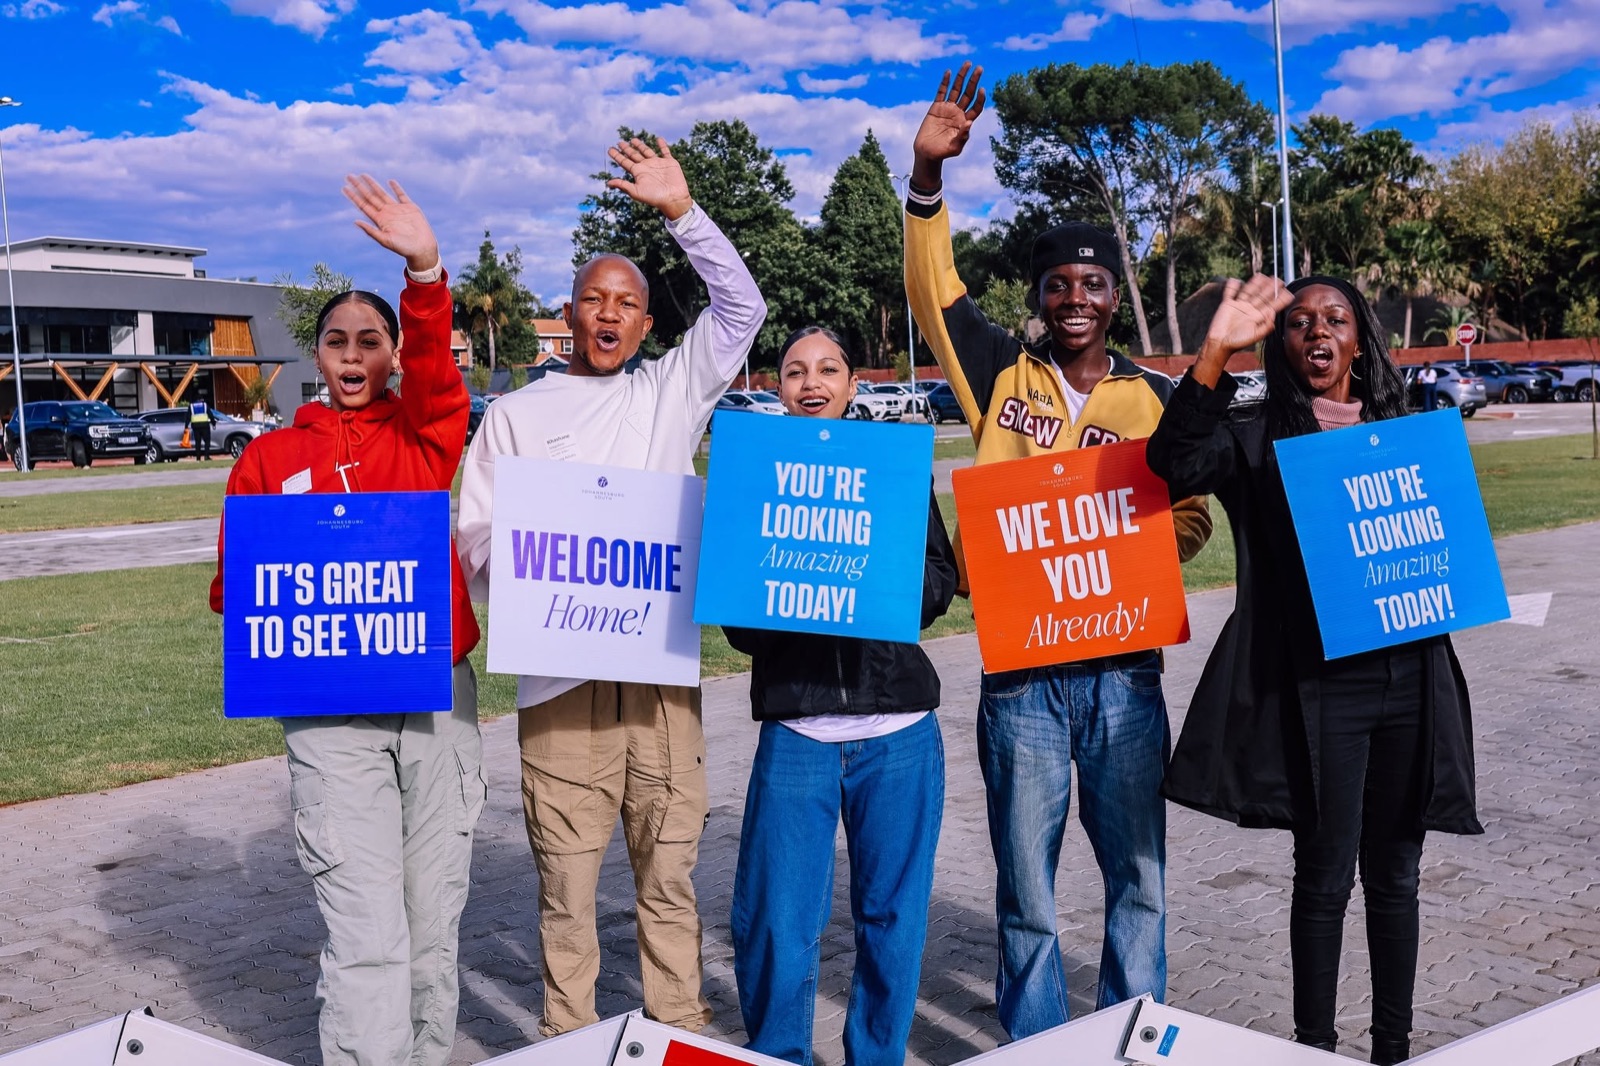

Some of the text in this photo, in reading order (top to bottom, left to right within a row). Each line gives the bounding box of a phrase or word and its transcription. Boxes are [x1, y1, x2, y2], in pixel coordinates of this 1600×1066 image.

[1457, 330, 1474, 340] STOP
[775, 461, 867, 503] YOU'RE
[1343, 464, 1428, 513] YOU'RE
[761, 503, 871, 546] LOOKING
[996, 486, 1140, 554] WE LOVE
[1348, 506, 1445, 558] LOOKING
[255, 560, 419, 607] IT'S GREAT
[511, 529, 682, 593] WELCOME
[760, 543, 869, 581] Amazing
[1041, 549, 1112, 603] YOU
[1364, 547, 1450, 588] Amazing
[543, 593, 651, 636] Home!
[765, 580, 856, 624] TODAY!
[1025, 597, 1149, 649] Already!
[1374, 583, 1456, 634] TODAY!
[245, 612, 427, 659] TO SEE YOU!
